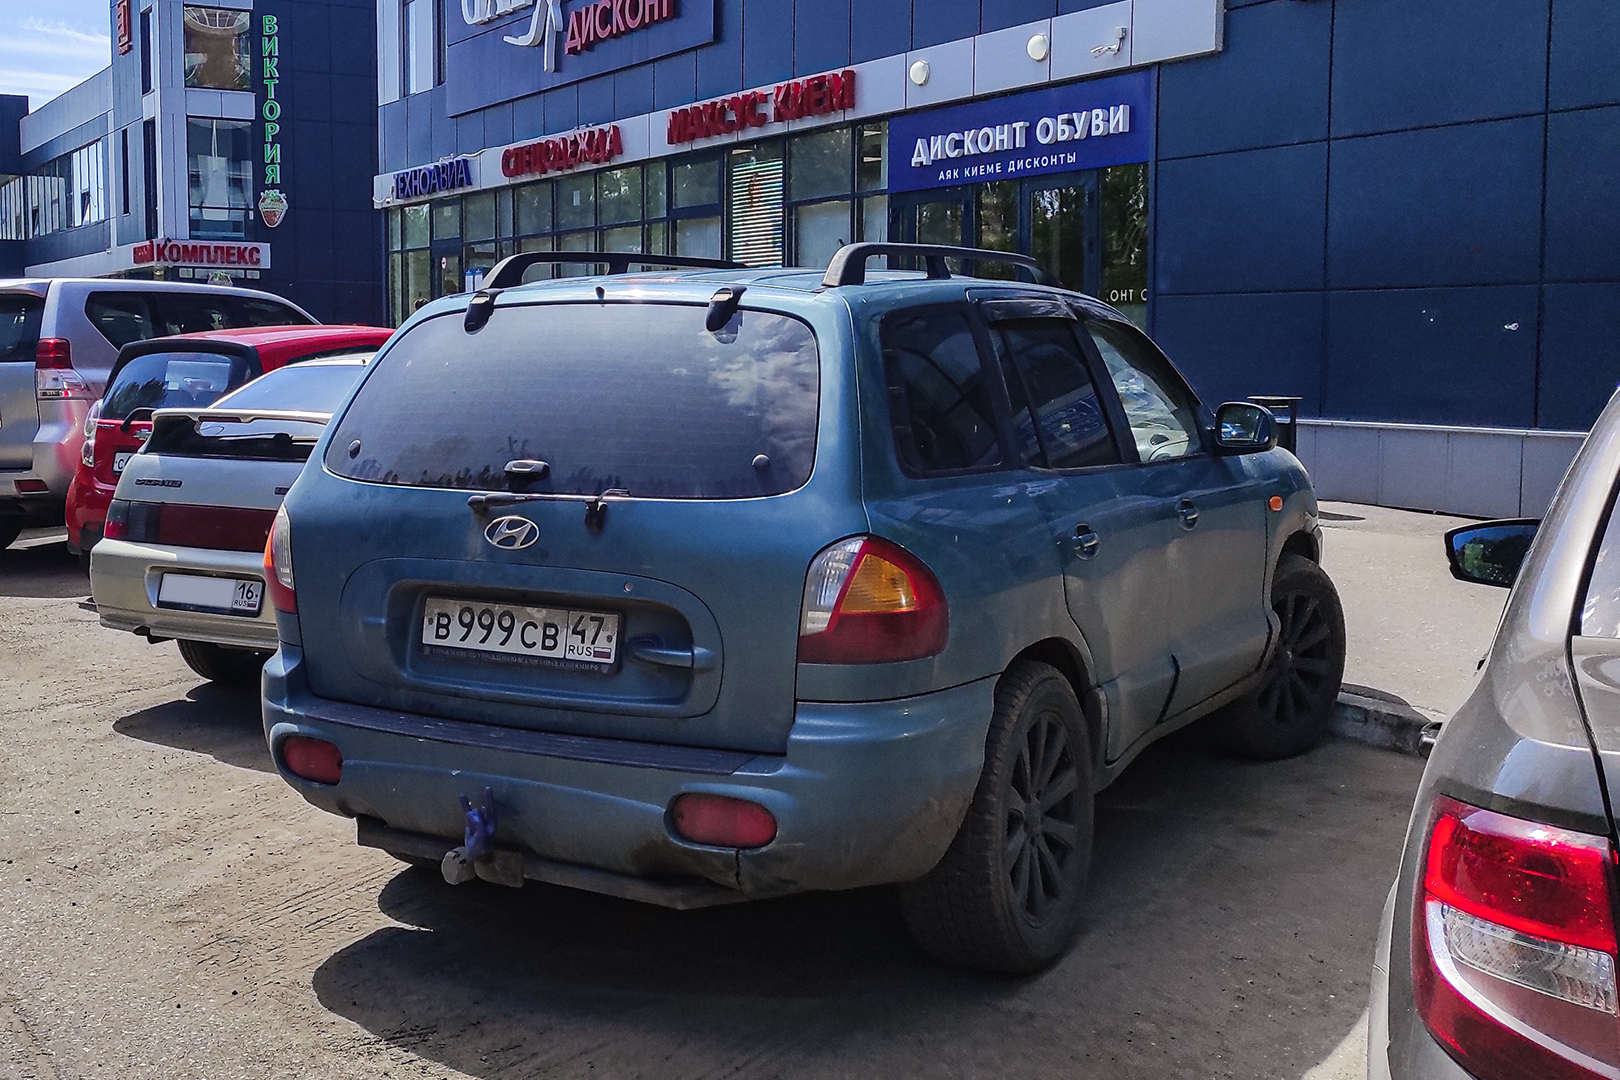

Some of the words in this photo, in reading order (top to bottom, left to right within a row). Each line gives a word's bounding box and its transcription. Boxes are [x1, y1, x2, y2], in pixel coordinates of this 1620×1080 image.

[262, 14, 281, 184] ВИКТОРИЯ
[773, 70, 855, 122] КИЕМ
[501, 124, 623, 178] СПЕЦОДЕЖДА
[911, 121, 1029, 167] ДИСКОНТ
[1036, 104, 1130, 145] ОБУВИ
[393, 158, 473, 200] ТЕХНОАВИА
[938, 168, 959, 181] АЯК
[964, 162, 1002, 178] КИЕМЕ
[1008, 151, 1077, 173] ДИСКОНТЫ
[156, 243, 261, 265] КОМПЛЕКС
[238, 583, 254, 600] 16
[571, 615, 605, 645] 47
[568, 645, 592, 657] RUS
